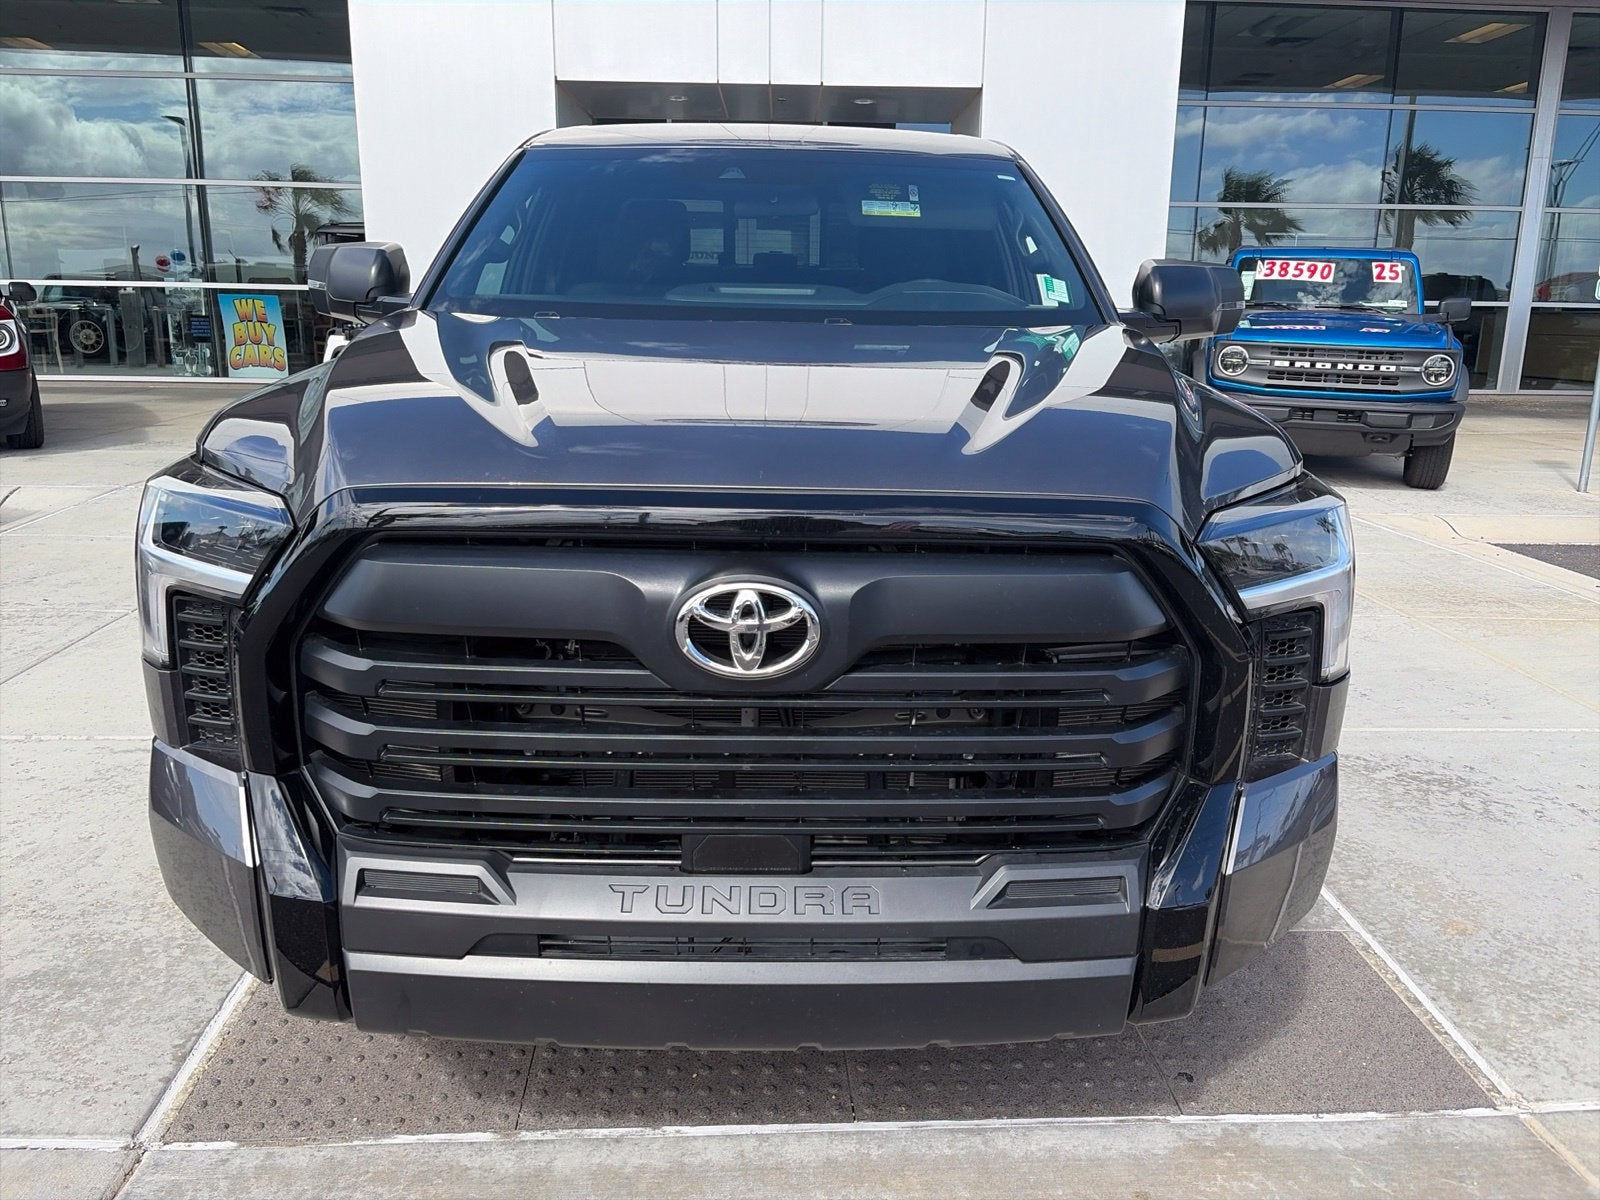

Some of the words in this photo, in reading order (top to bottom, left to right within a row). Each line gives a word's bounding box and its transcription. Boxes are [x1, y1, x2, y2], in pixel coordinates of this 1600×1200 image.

[1374, 263, 1400, 281] 25
[233, 298, 268, 323] WE
[233, 321, 276, 346] BUY
[229, 344, 286, 371] CARS
[1274, 361, 1397, 372] BRONCO
[609, 884, 880, 915] TUNDRA
